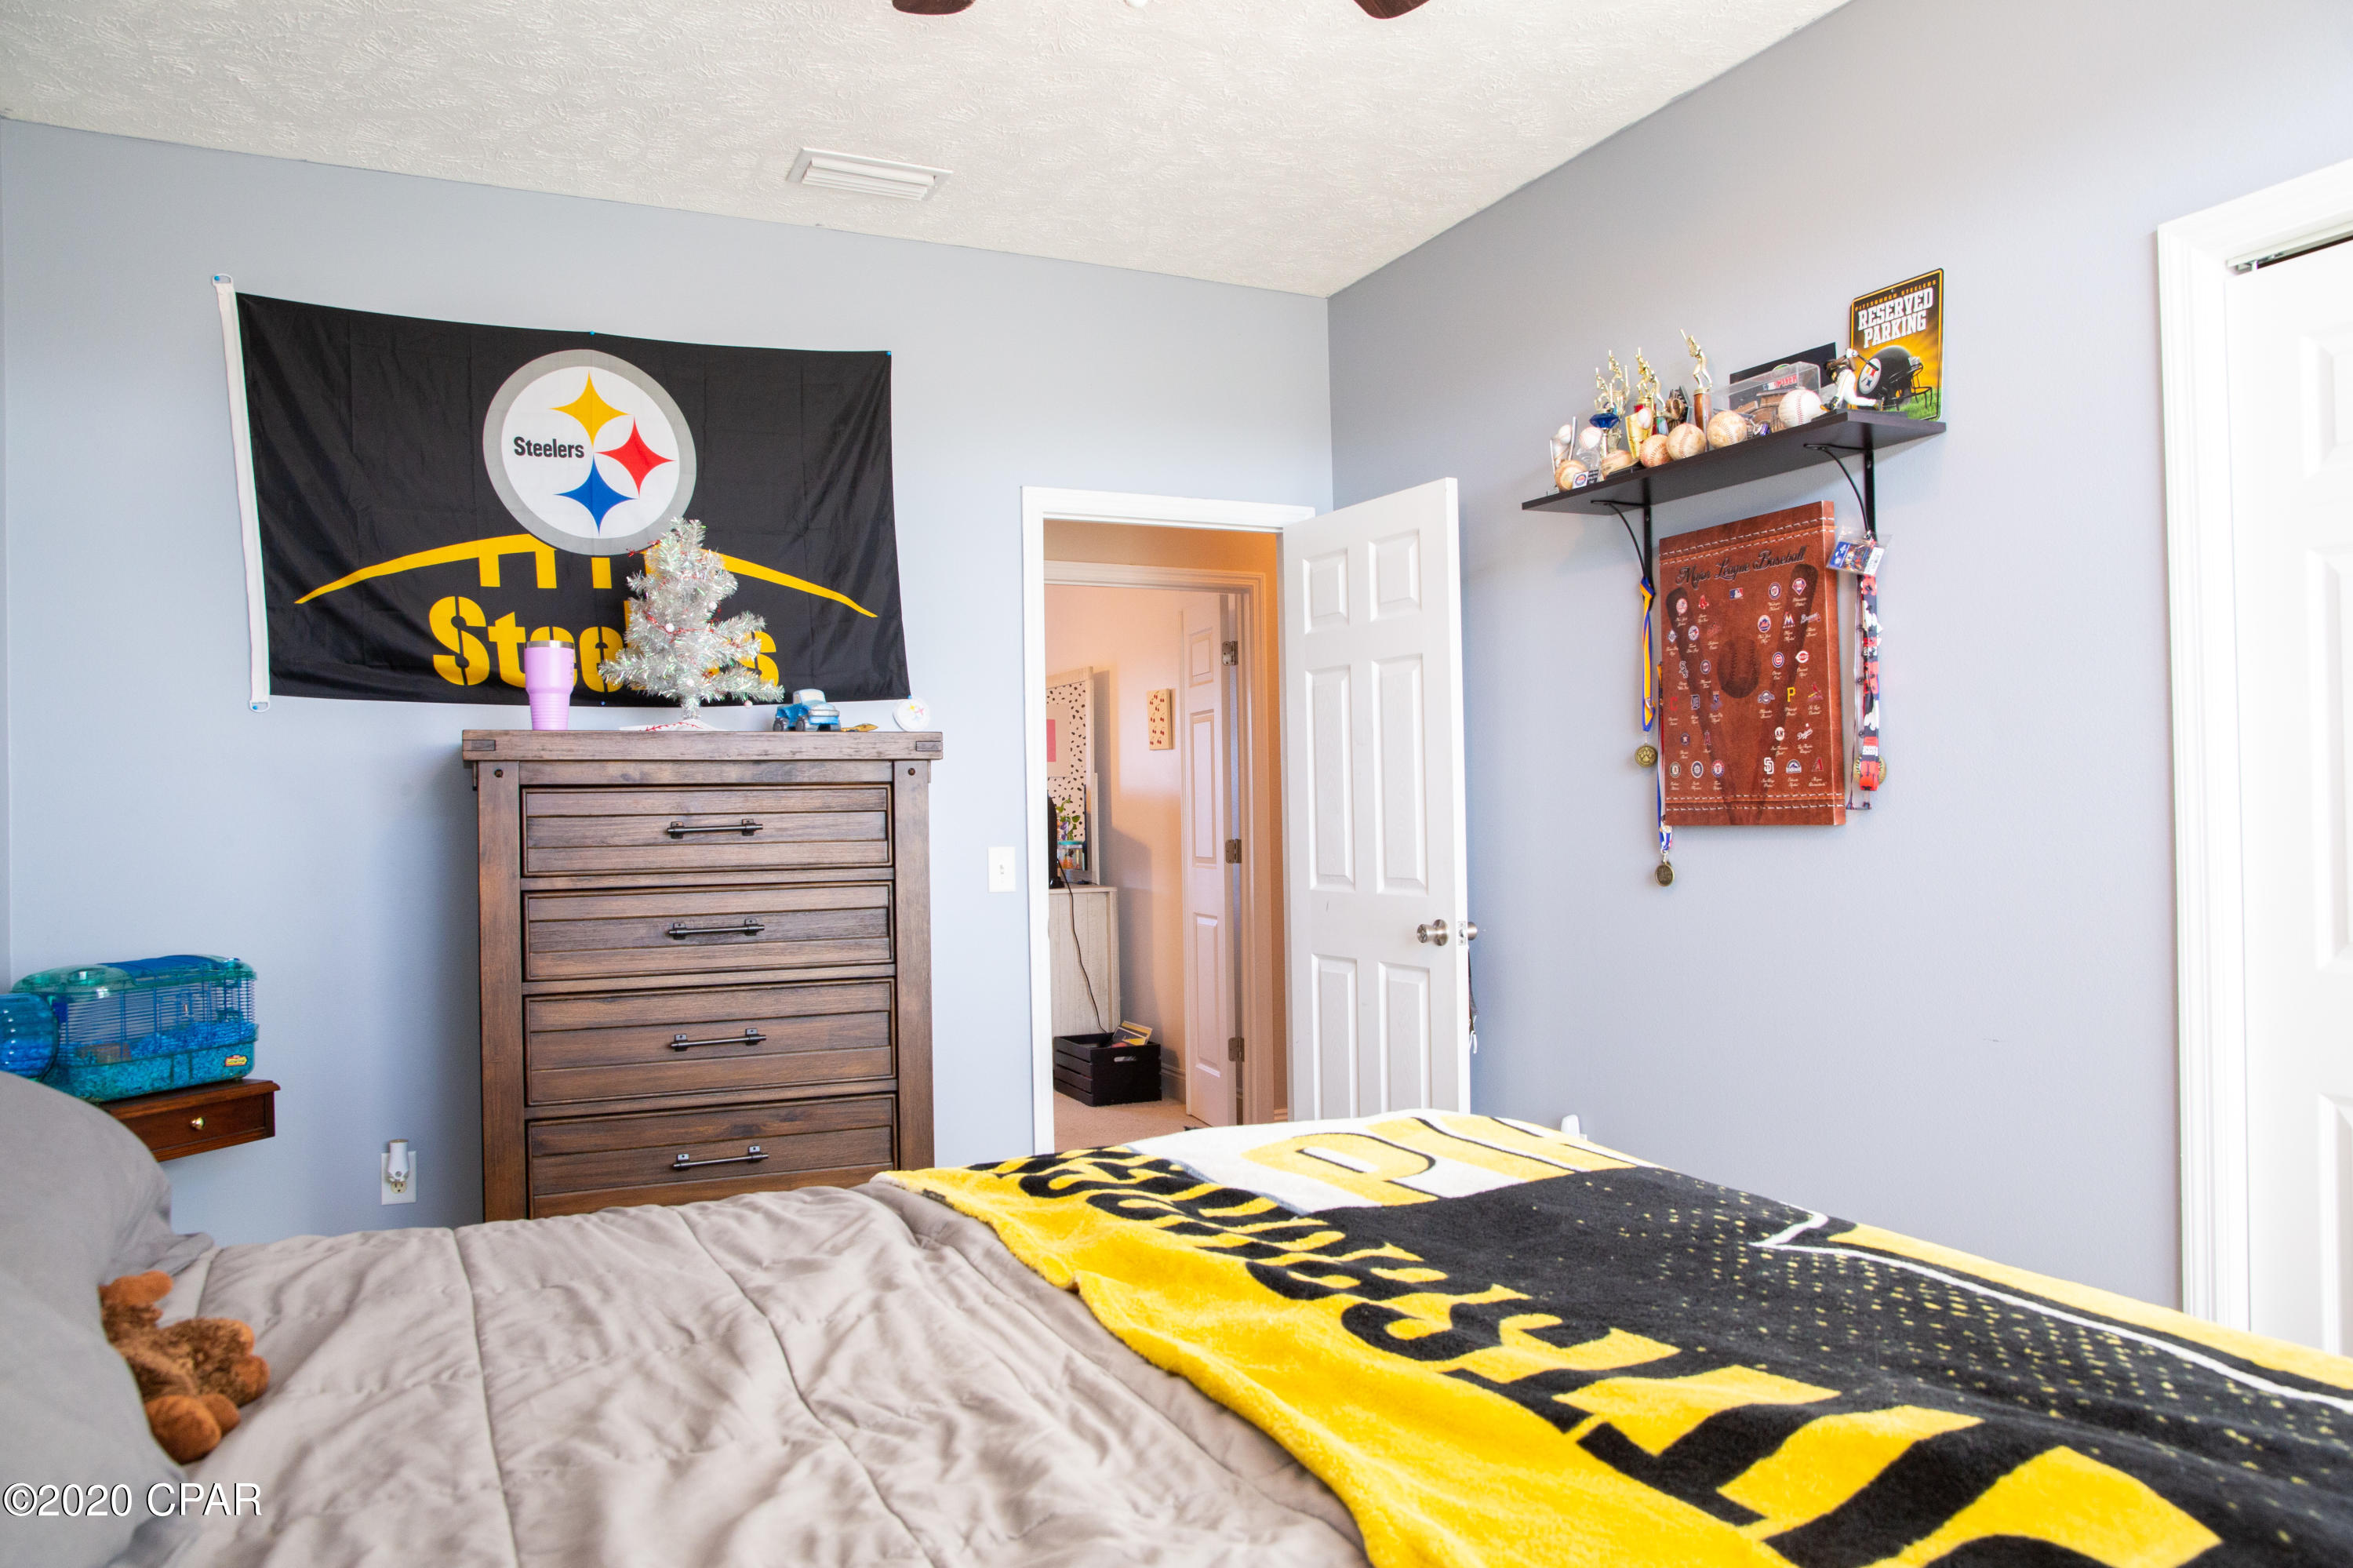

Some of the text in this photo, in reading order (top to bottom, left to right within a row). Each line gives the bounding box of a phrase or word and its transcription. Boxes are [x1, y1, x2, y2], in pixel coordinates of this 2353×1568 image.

[1901, 279, 1937, 297] STEELERS
[1857, 287, 1934, 331] RESERVED
[1863, 309, 1927, 349] PARKING
[513, 436, 585, 458] Steelers
[1714, 557, 1751, 580] League
[1752, 546, 1807, 570] Baseball
[1787, 686, 1796, 703] P
